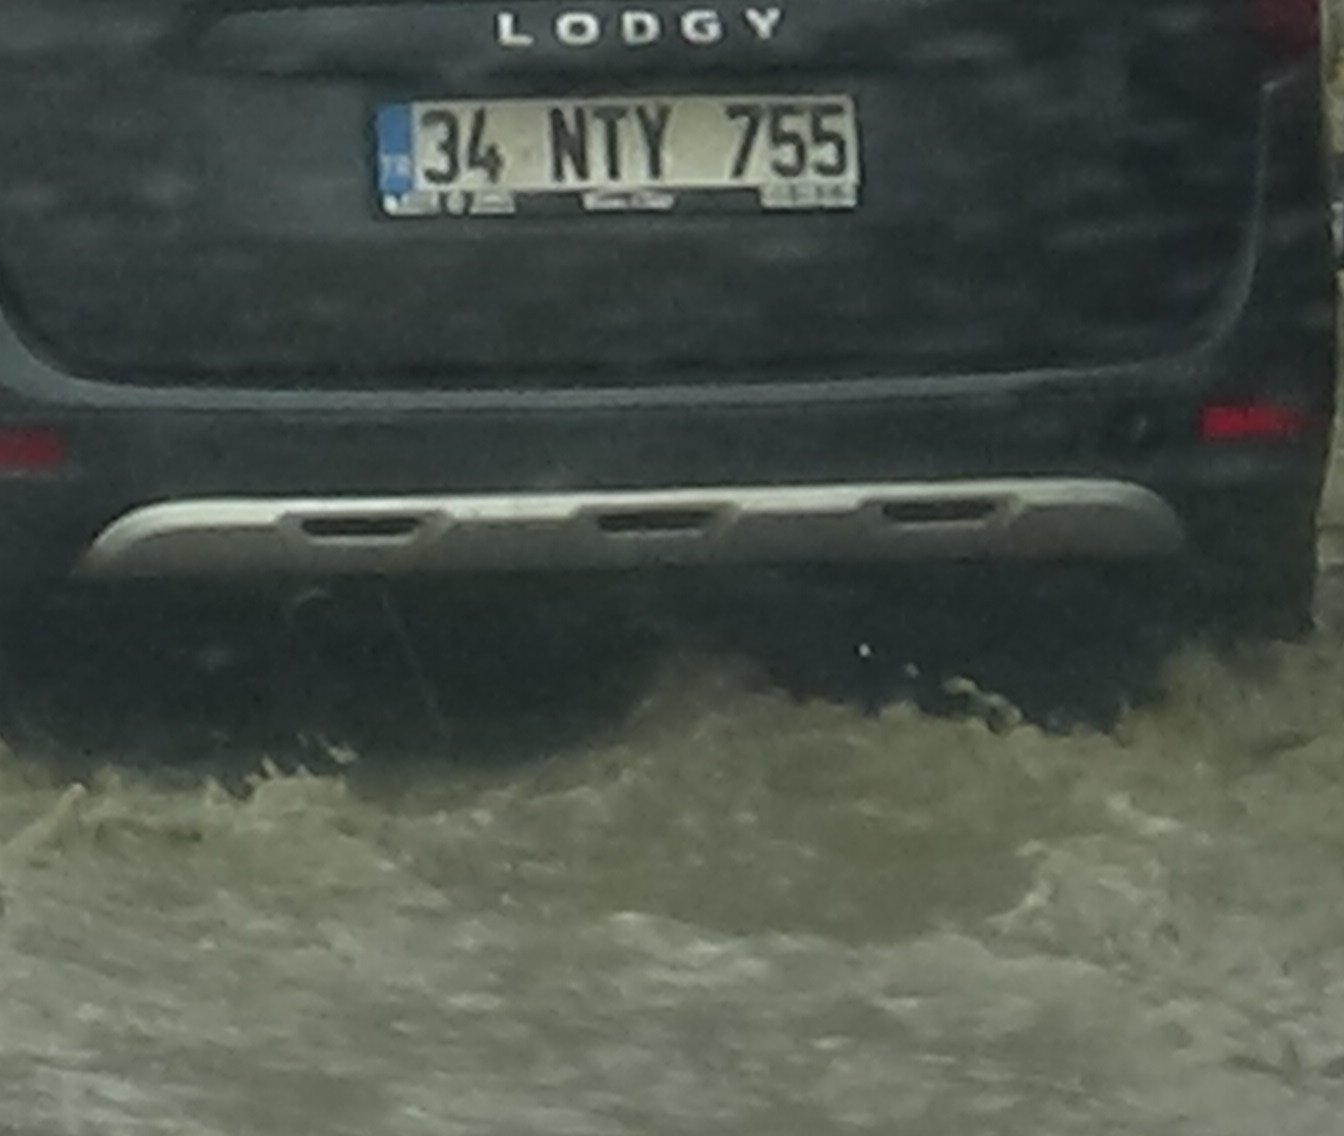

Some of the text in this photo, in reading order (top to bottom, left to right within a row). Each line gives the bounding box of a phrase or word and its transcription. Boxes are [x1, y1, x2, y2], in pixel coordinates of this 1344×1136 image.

[496, 8, 782, 47] LODGY
[419, 107, 506, 185] 34
[549, 105, 671, 183] NTY
[725, 104, 848, 180] 755
